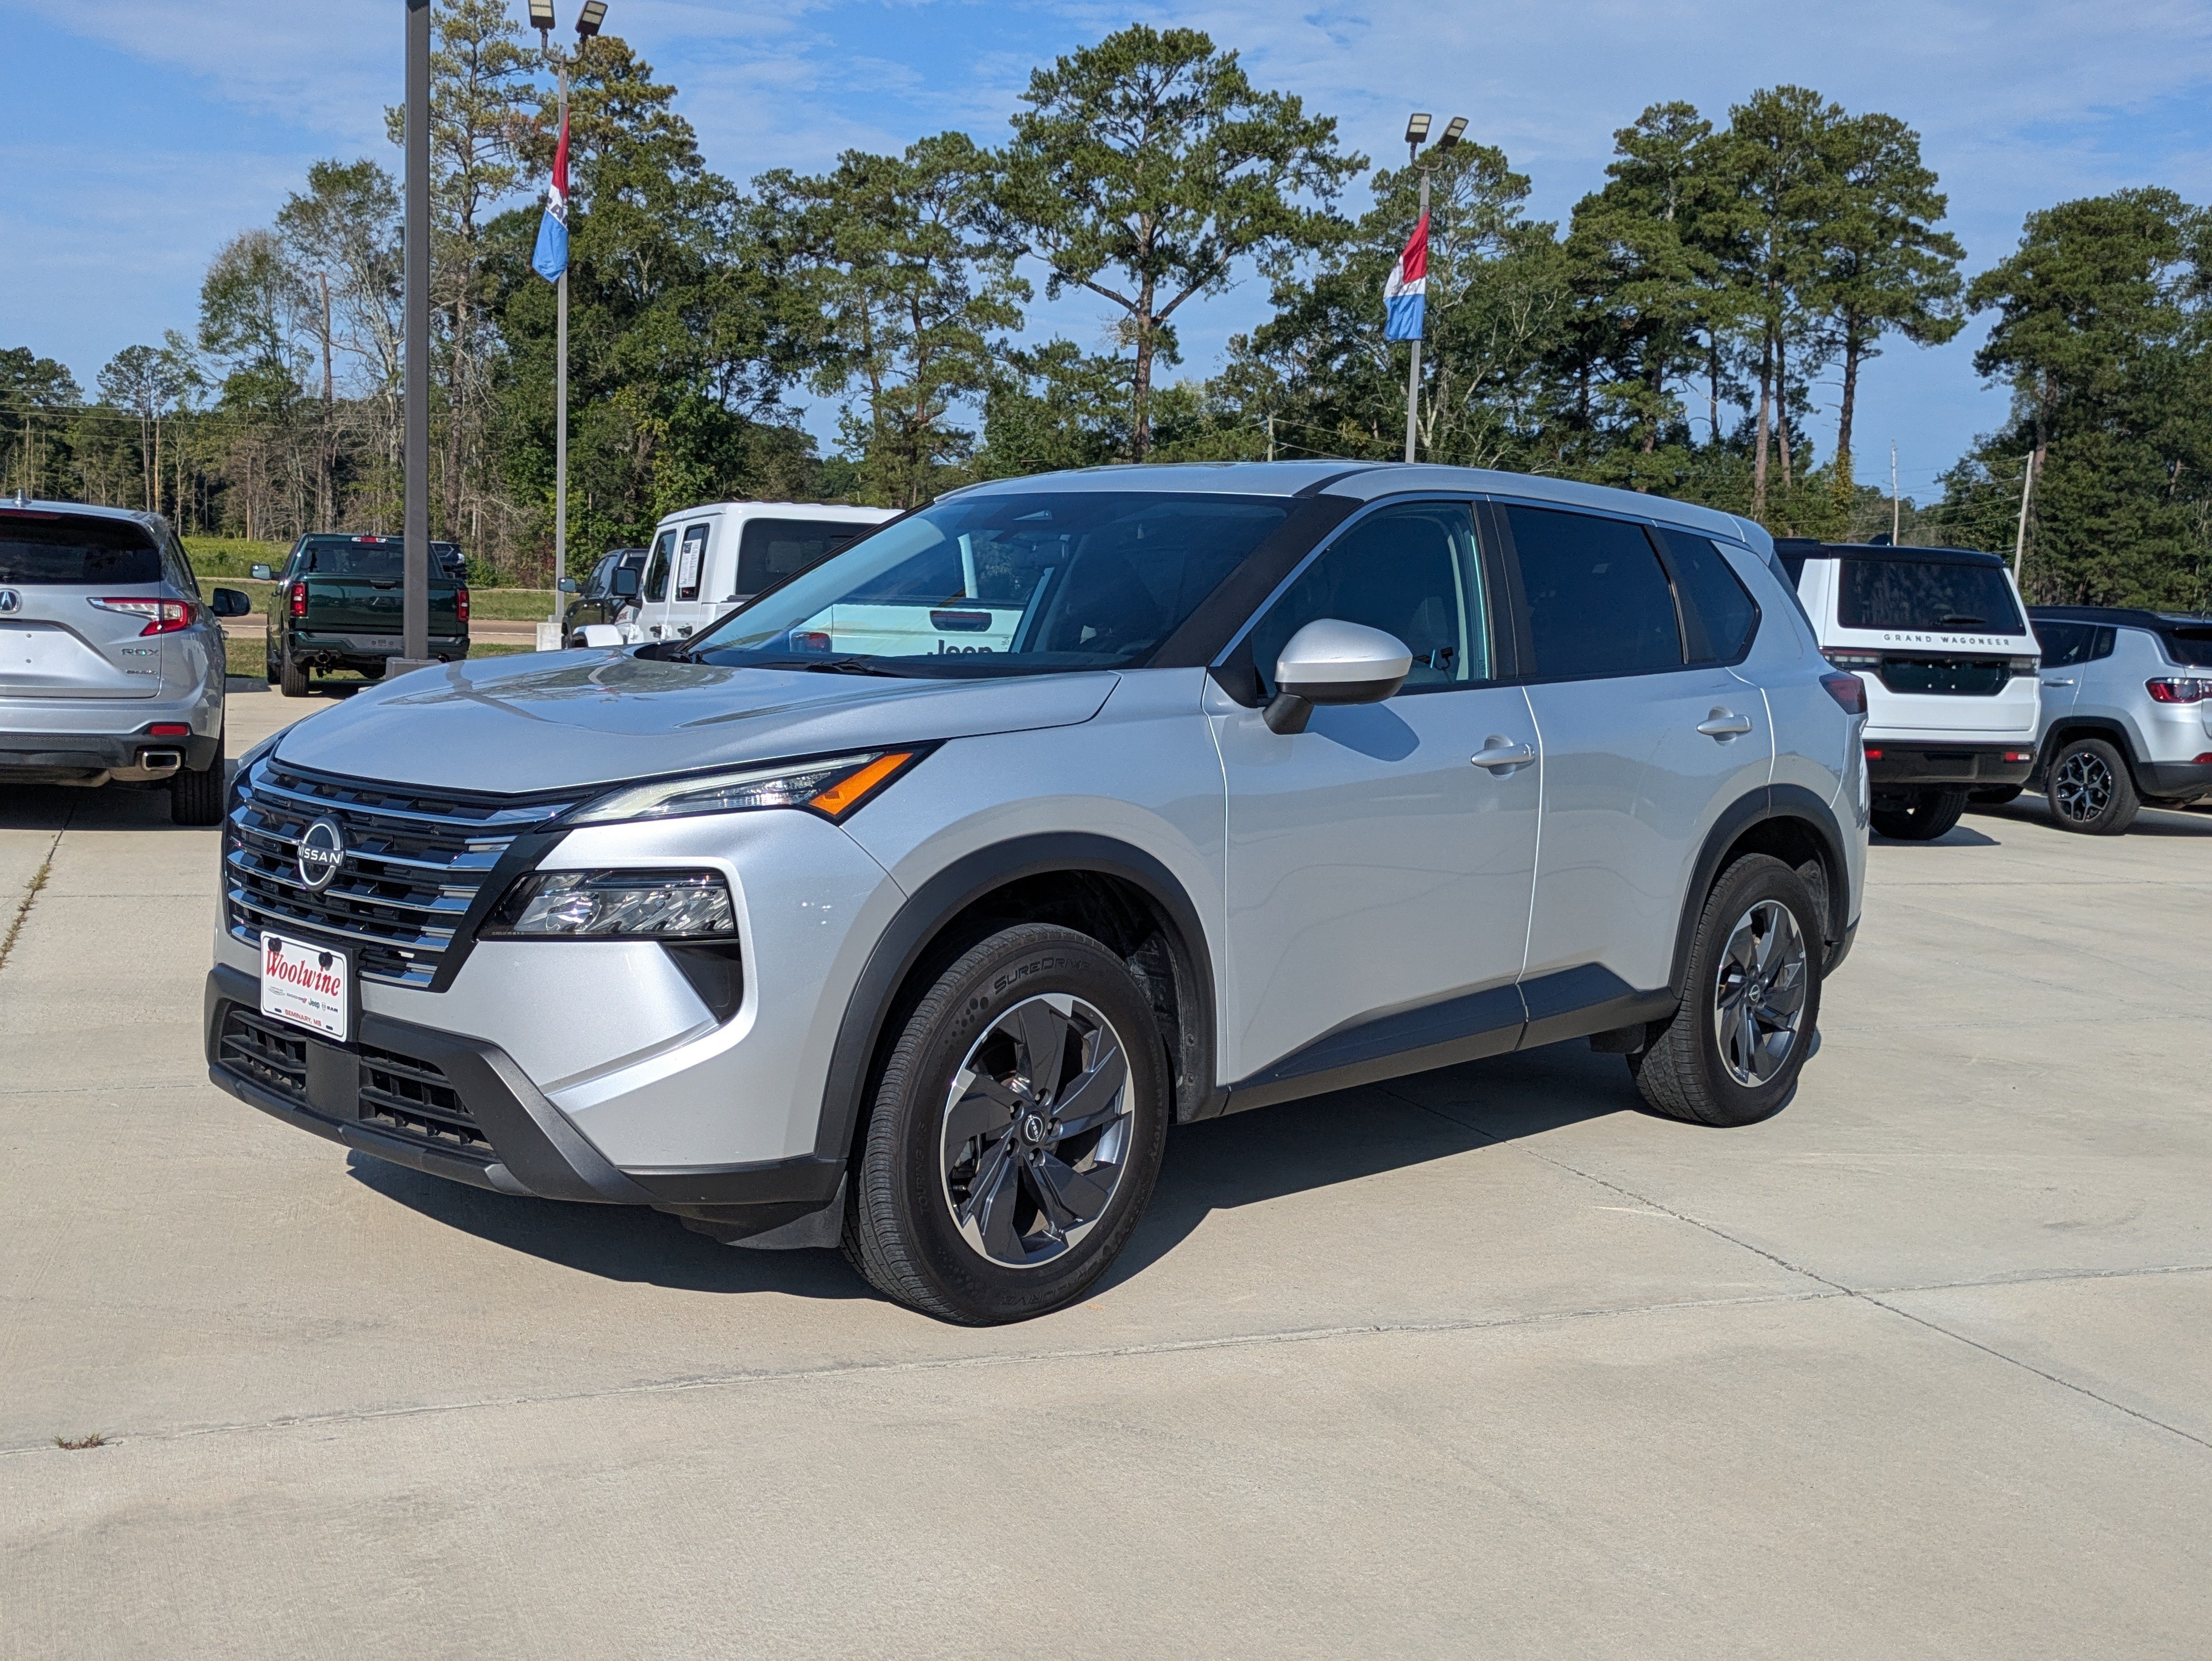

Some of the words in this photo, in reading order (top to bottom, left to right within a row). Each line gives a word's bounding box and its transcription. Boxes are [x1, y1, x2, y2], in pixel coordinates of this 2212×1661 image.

[1884, 634, 1932, 642] GRAND
[1940, 636, 2010, 646] WAGONEER
[298, 846, 341, 864] NISSAN
[266, 950, 341, 997] Woolwine
